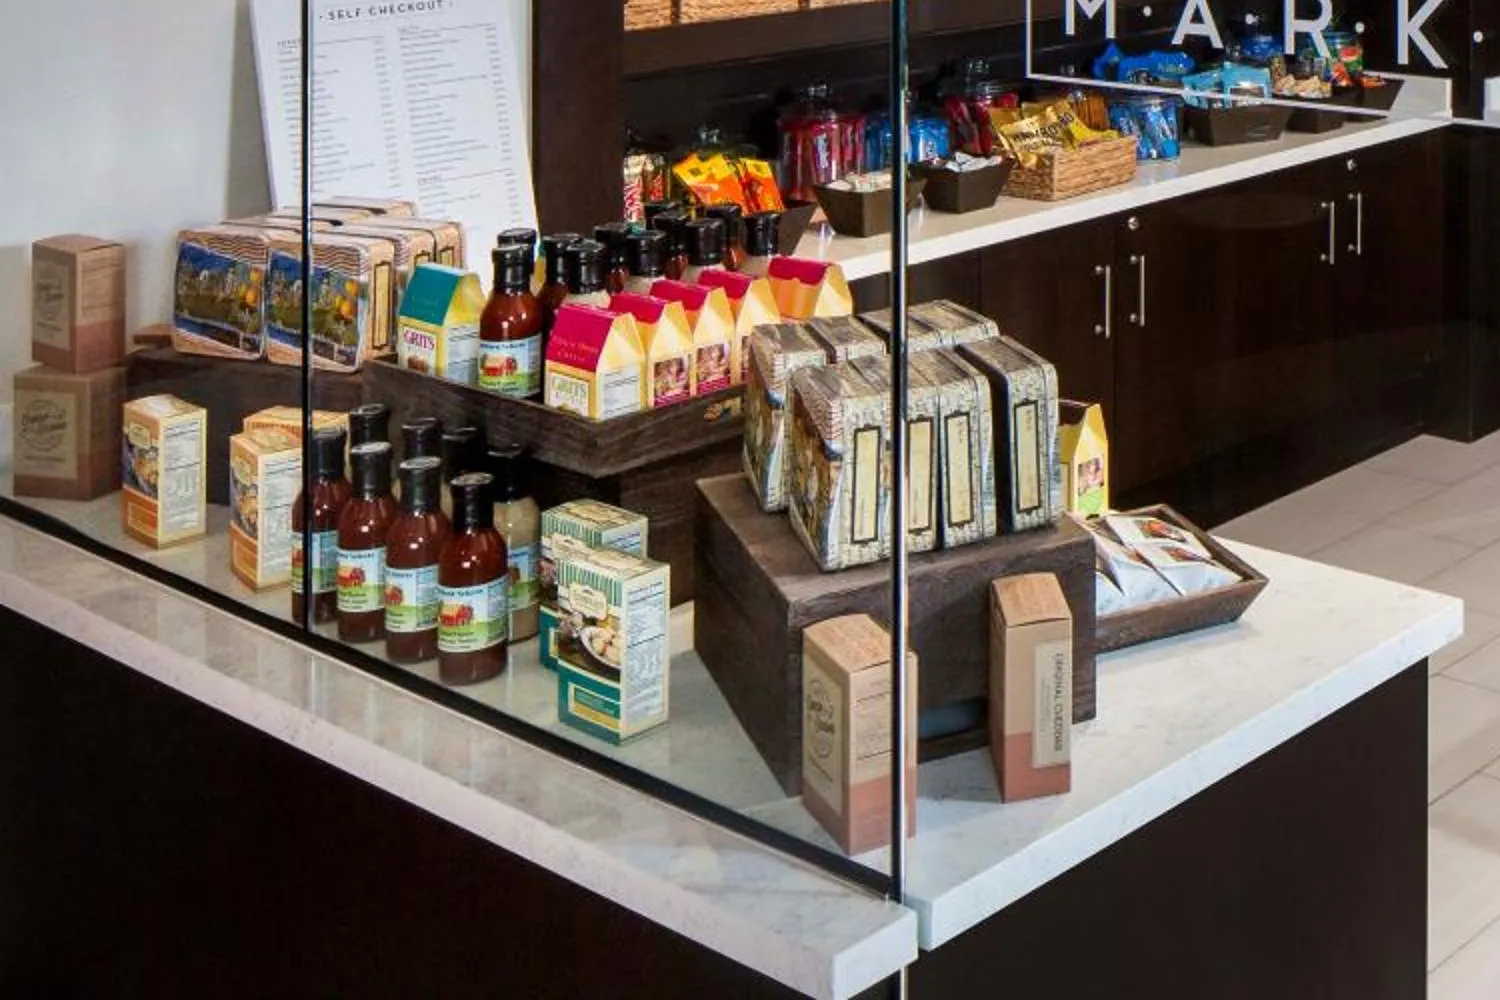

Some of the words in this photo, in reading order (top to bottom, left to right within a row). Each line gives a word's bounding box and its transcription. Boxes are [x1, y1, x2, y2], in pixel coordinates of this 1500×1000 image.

[327, 7, 363, 21] SELF
[368, 0, 444, 17] CHECKOUT
[403, 329, 436, 350] GRITS
